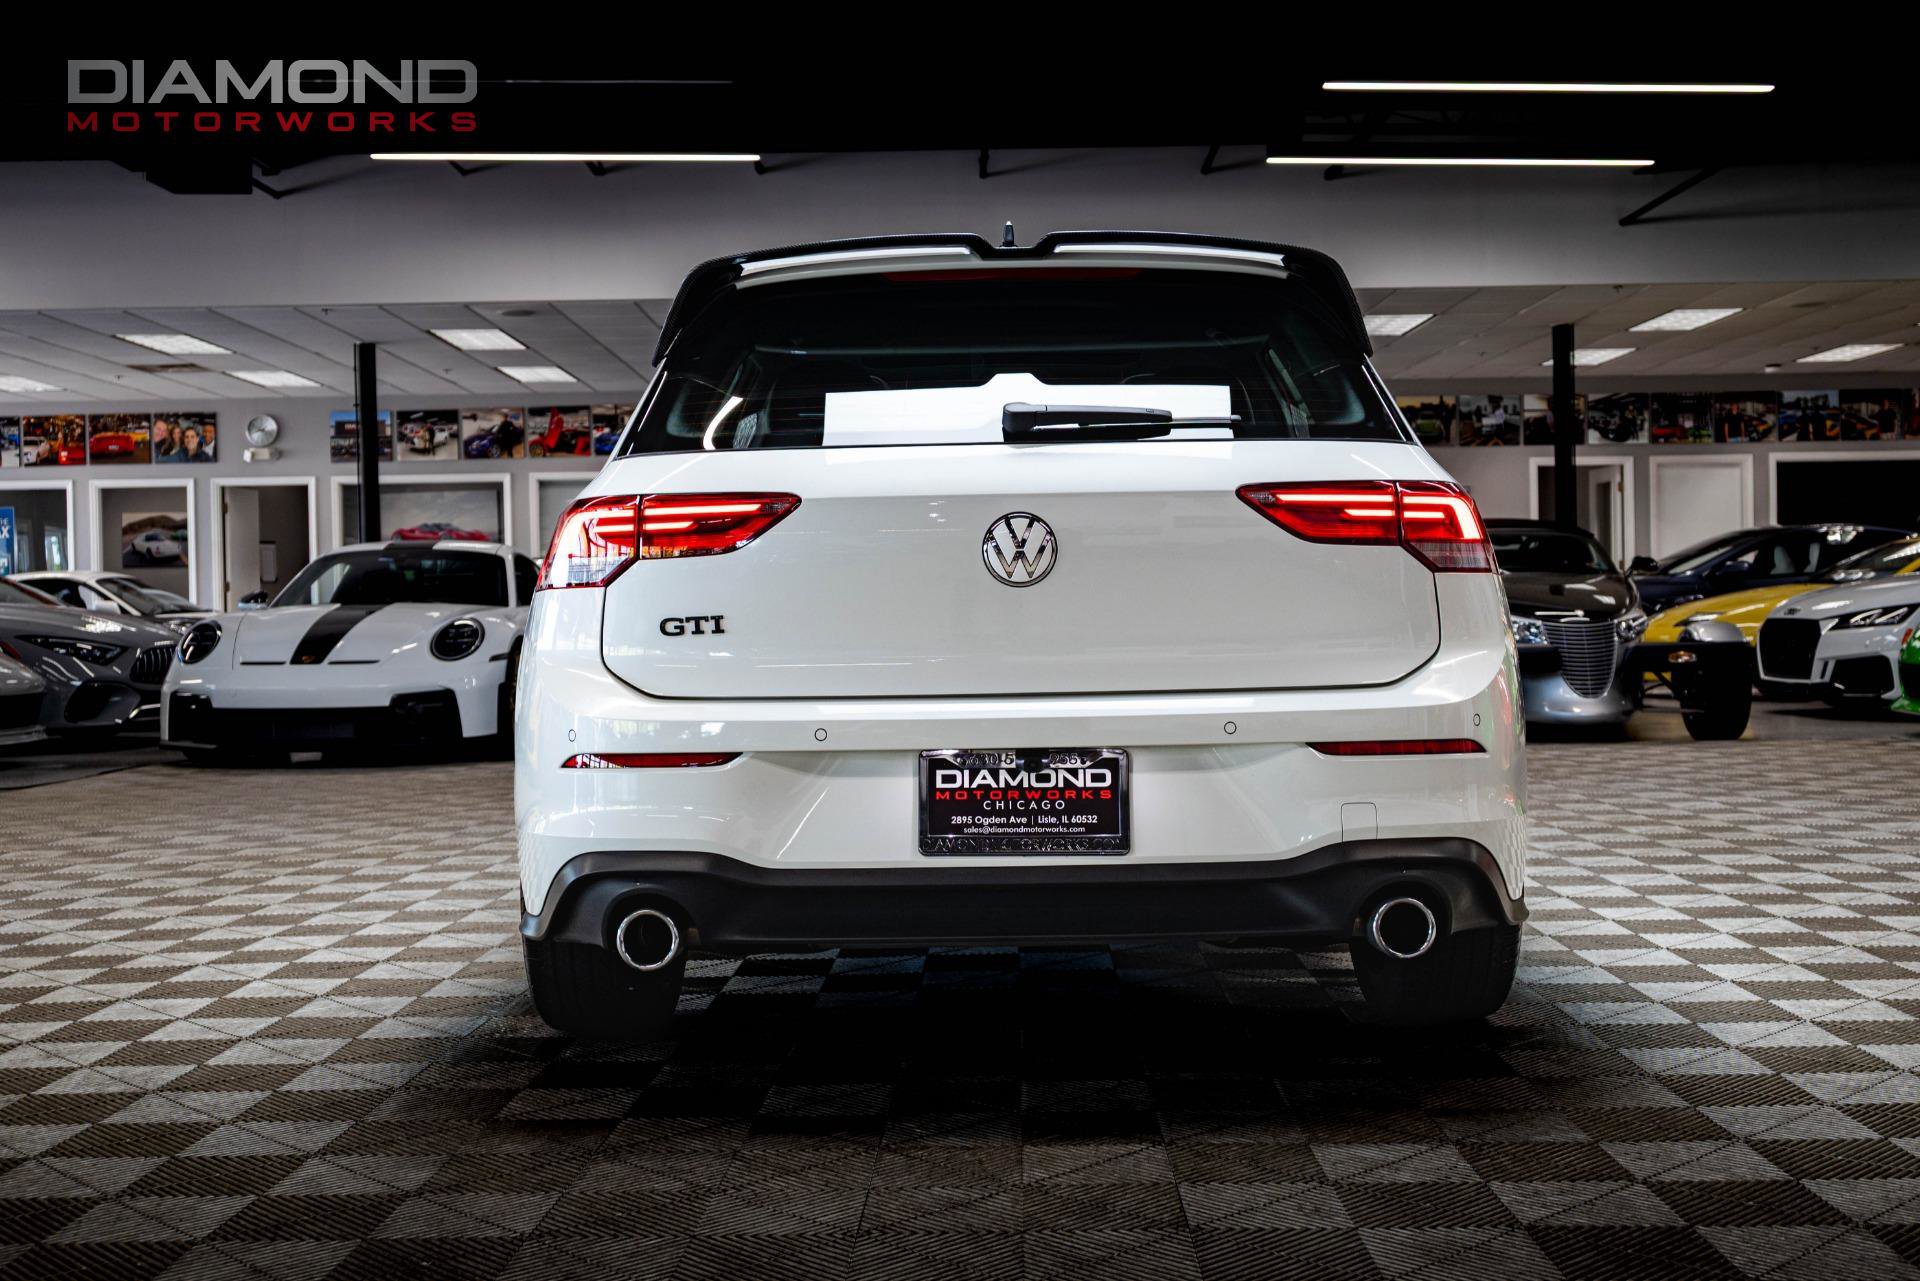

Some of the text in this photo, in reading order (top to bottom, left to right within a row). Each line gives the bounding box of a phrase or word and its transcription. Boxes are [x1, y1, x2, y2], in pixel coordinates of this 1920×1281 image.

[659, 614, 726, 637] GTI
[935, 769, 1112, 789] DIAMOND
[935, 789, 1112, 801] MOTORWORKS
[983, 800, 1065, 811] CHICAGO
[951, 814, 1098, 827] 2895 Ogden Ave Lisle, IL 60532
[963, 825, 1086, 834] sales@diamondmotorworks.com
